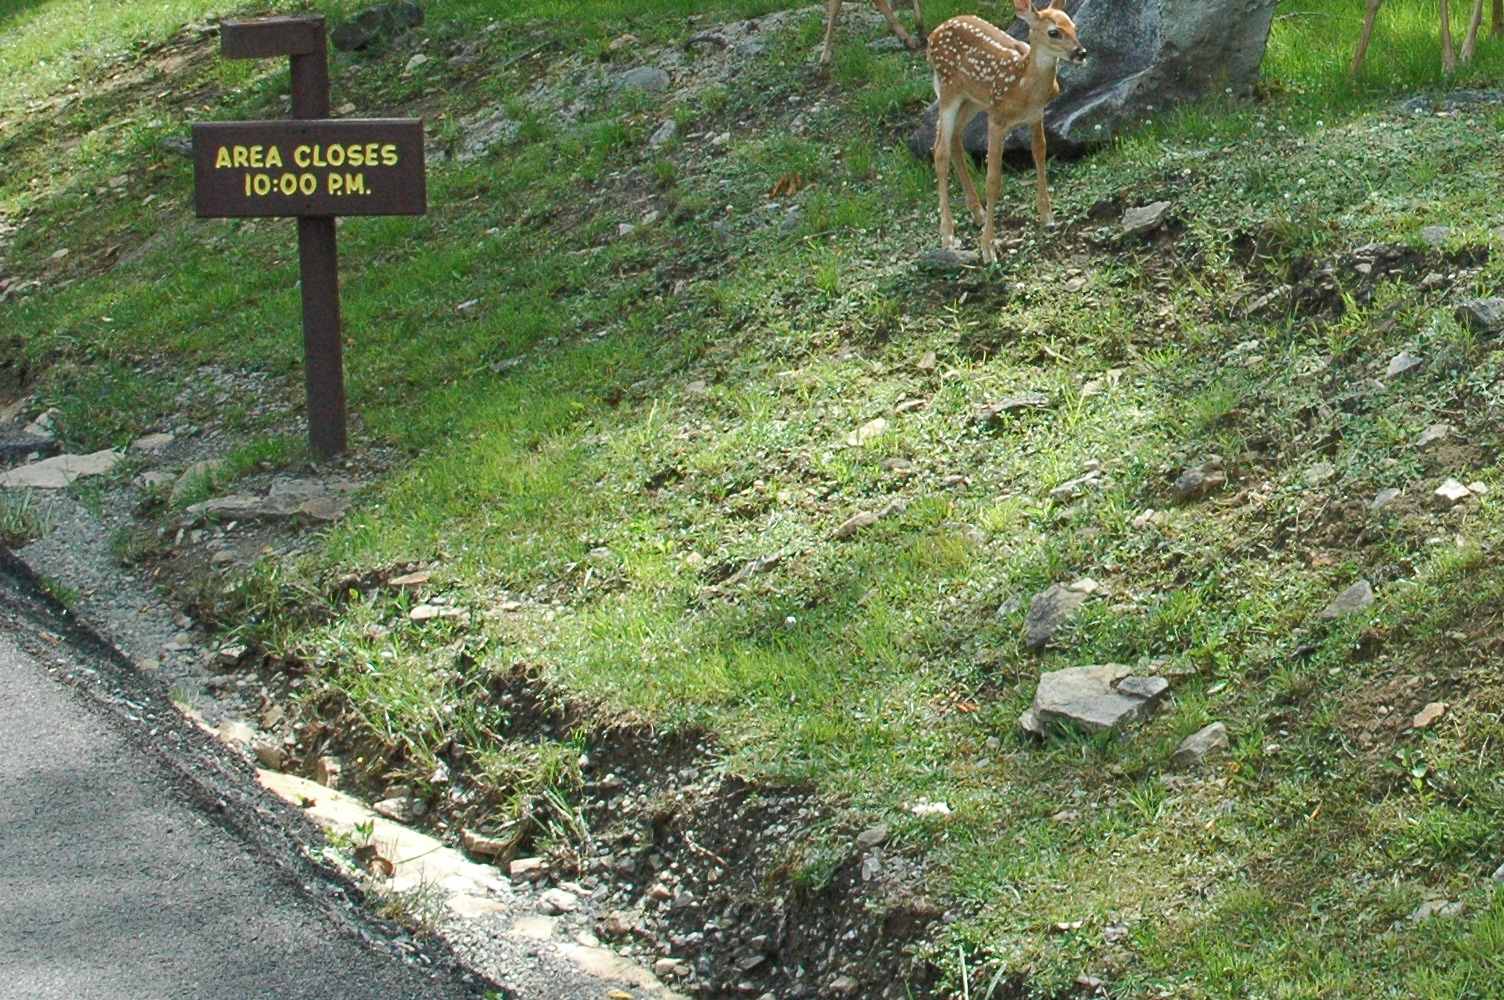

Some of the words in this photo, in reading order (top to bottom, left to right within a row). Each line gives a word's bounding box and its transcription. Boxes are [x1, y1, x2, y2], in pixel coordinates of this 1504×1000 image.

[215, 145, 282, 168] AREA
[293, 143, 398, 167] CLOSES
[245, 172, 317, 196] 10:00
[328, 172, 371, 196] P.M.
